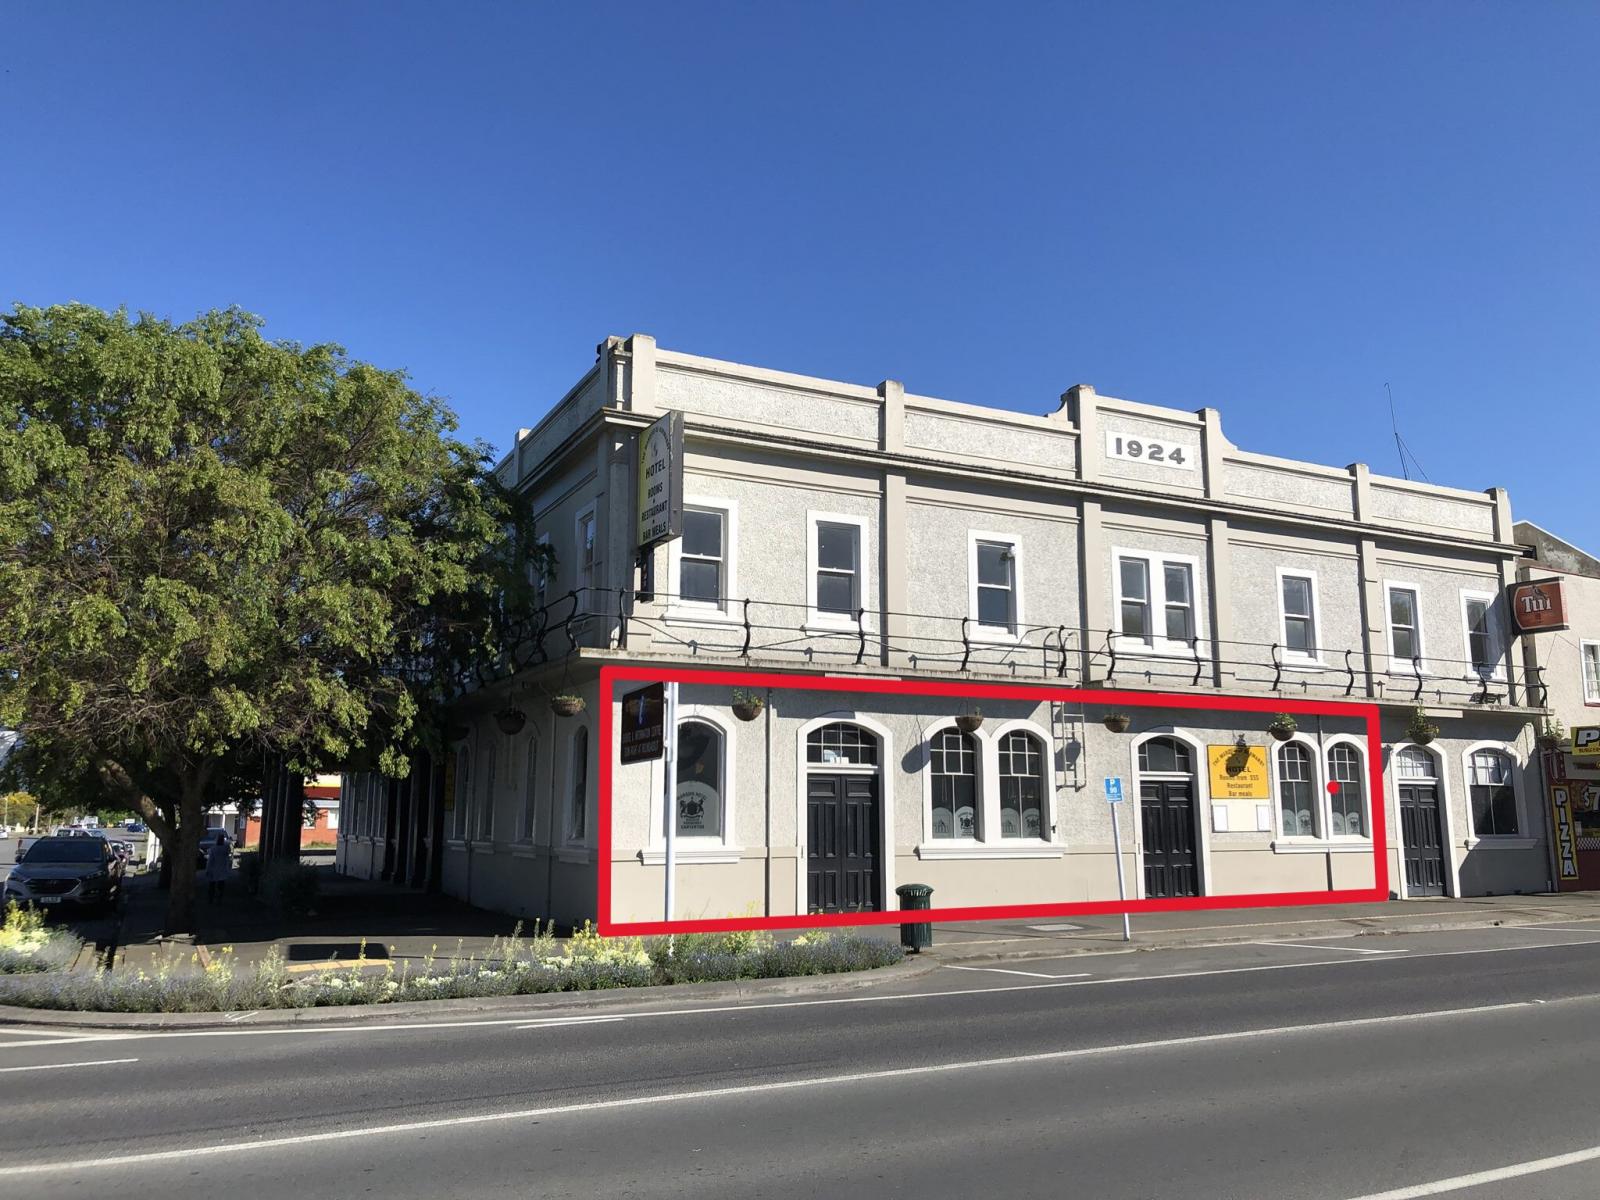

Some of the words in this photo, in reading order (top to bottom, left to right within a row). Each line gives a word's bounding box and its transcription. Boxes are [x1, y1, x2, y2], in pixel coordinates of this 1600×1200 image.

[1115, 437, 1186, 465] 1924
[645, 458, 666, 480] HOTEL
[647, 482, 663, 499] ROOMS
[641, 501, 668, 522] RESTAURANT
[642, 528, 651, 541] BAR
[651, 521, 666, 538] MEALS
[1521, 595, 1552, 613] Tui
[1554, 788, 1577, 878] PIZZA
